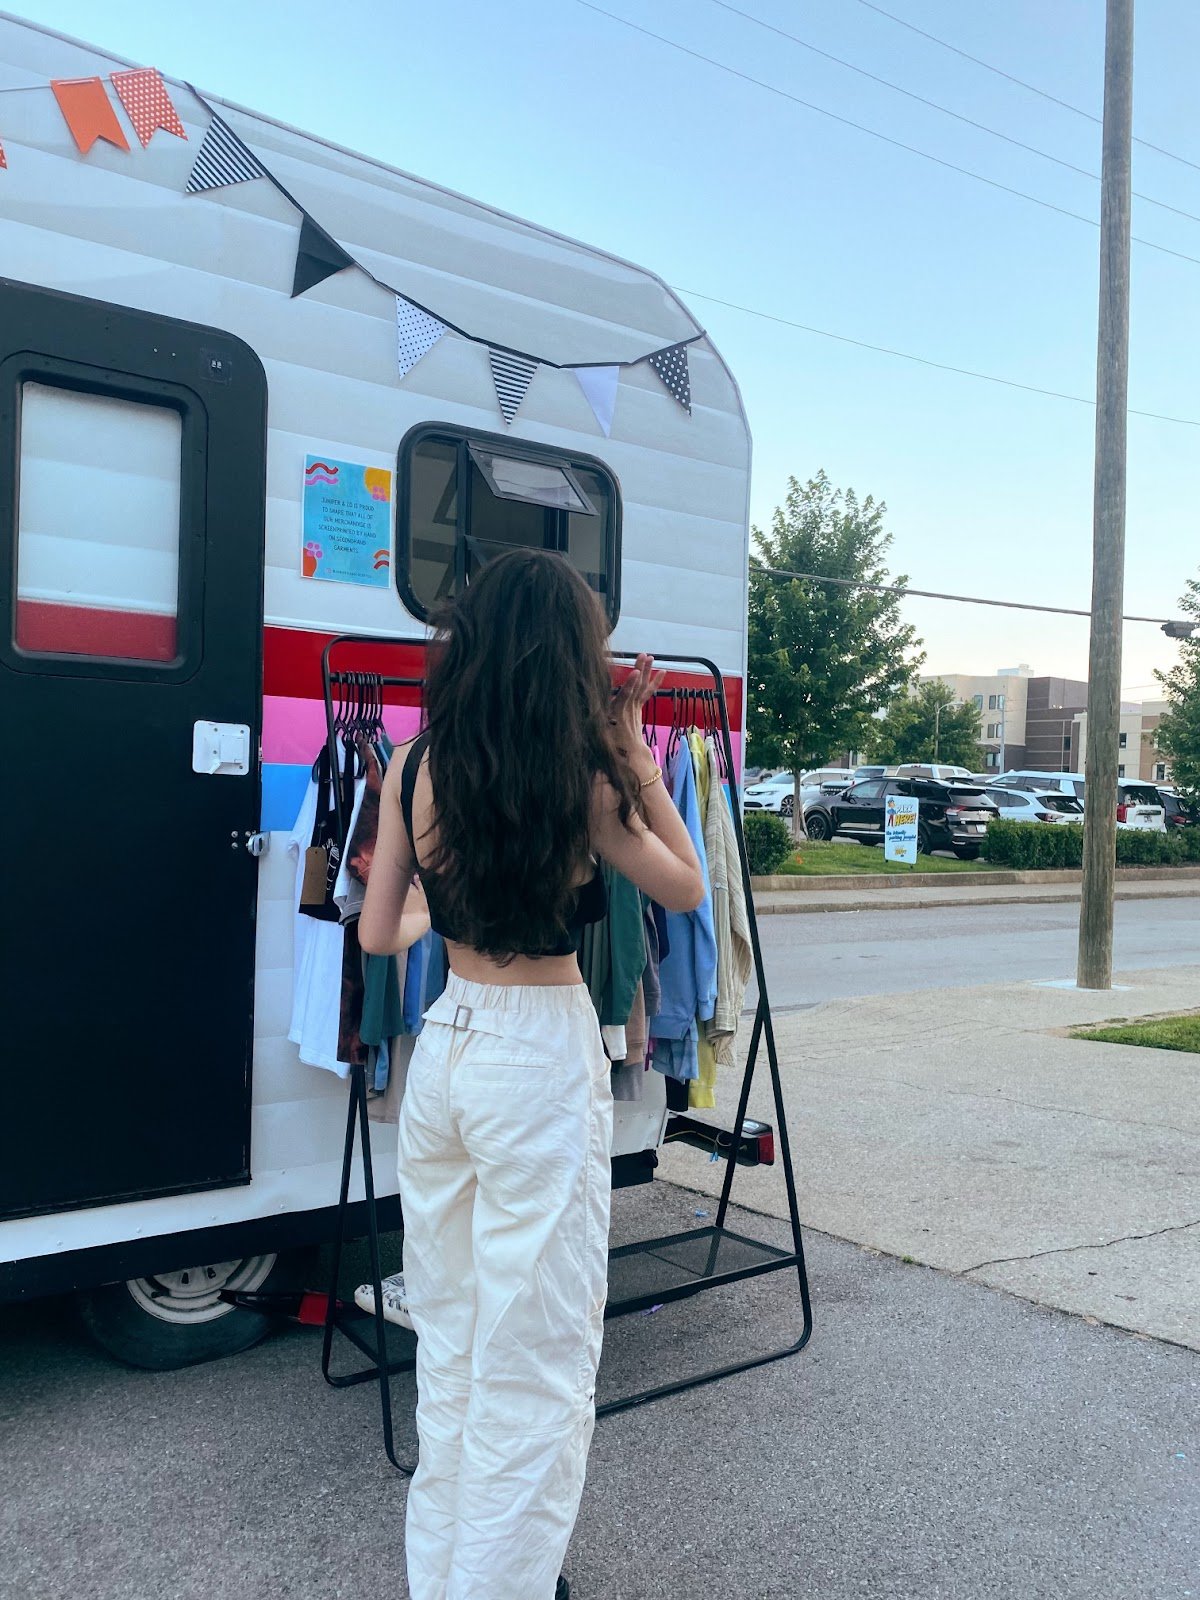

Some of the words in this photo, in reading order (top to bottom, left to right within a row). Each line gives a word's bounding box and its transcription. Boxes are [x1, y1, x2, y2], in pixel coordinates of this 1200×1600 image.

[330, 508, 344, 516] SHARE
[360, 504, 374, 512] PROUD
[334, 518, 366, 528] MERCHANDISE
[318, 524, 356, 535] SCREENPRINTED
[336, 536, 366, 546] SECONDHAND
[334, 544, 358, 554] GARMENTS
[895, 812, 916, 826] HERE!
